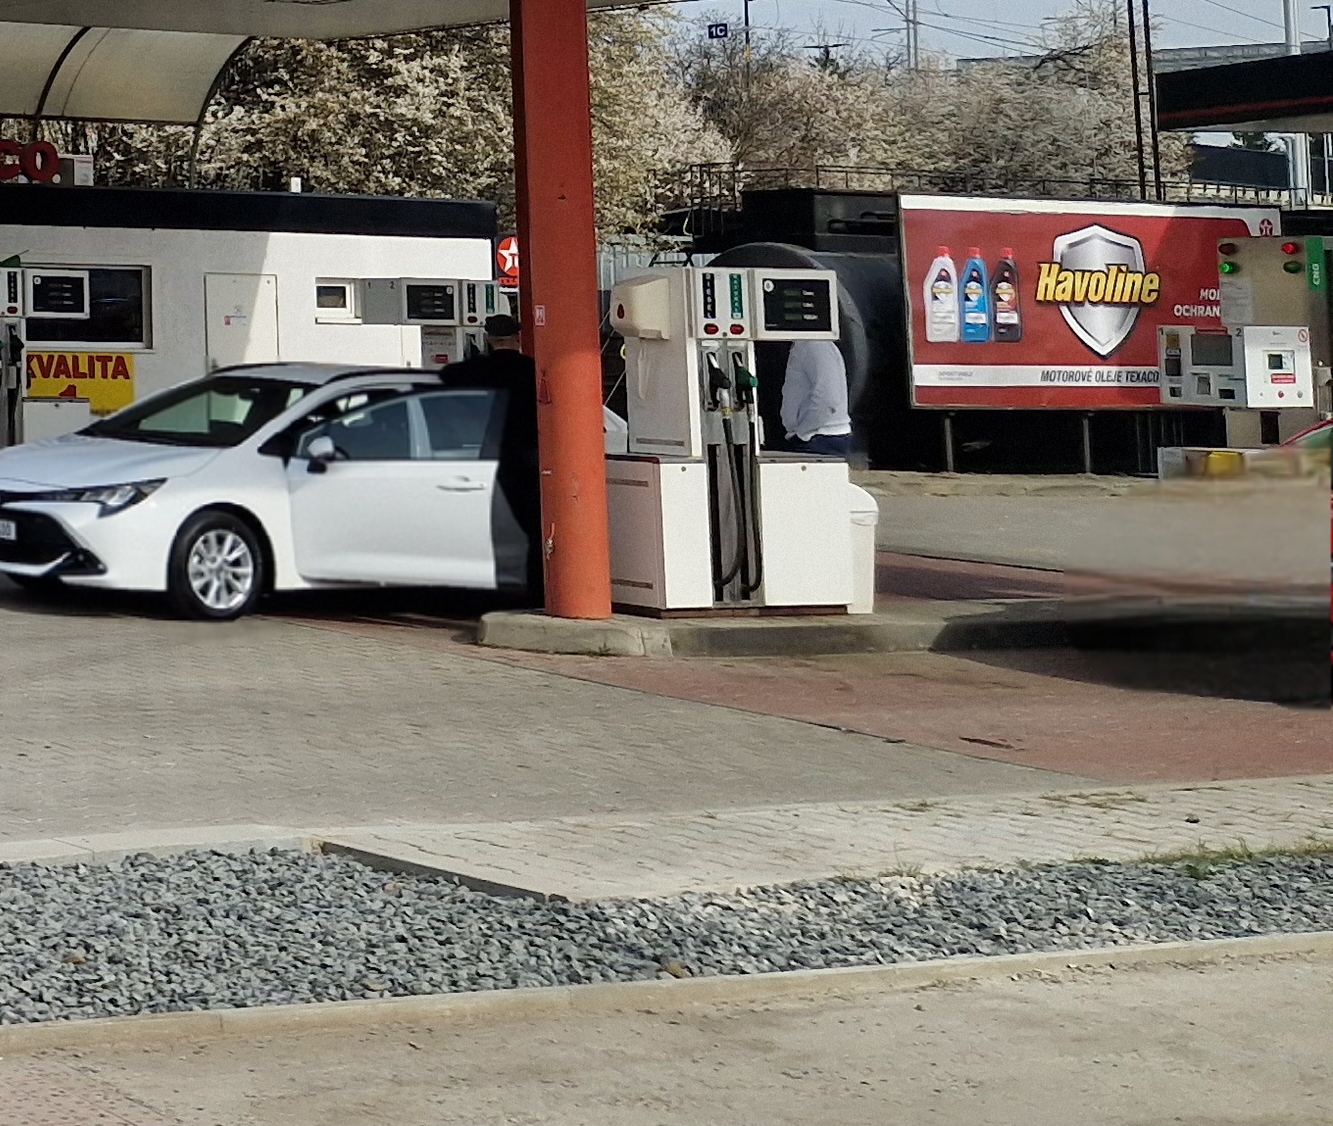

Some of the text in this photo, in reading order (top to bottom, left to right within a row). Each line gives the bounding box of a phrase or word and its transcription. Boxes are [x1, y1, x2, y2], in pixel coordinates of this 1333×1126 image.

[710, 26, 726, 36] 1C
[1035, 262, 1161, 304] Havoline
[1236, 328, 1242, 337] 2
[1040, 368, 1159, 383] MOTOROVÉ OLEJE TEXACO
